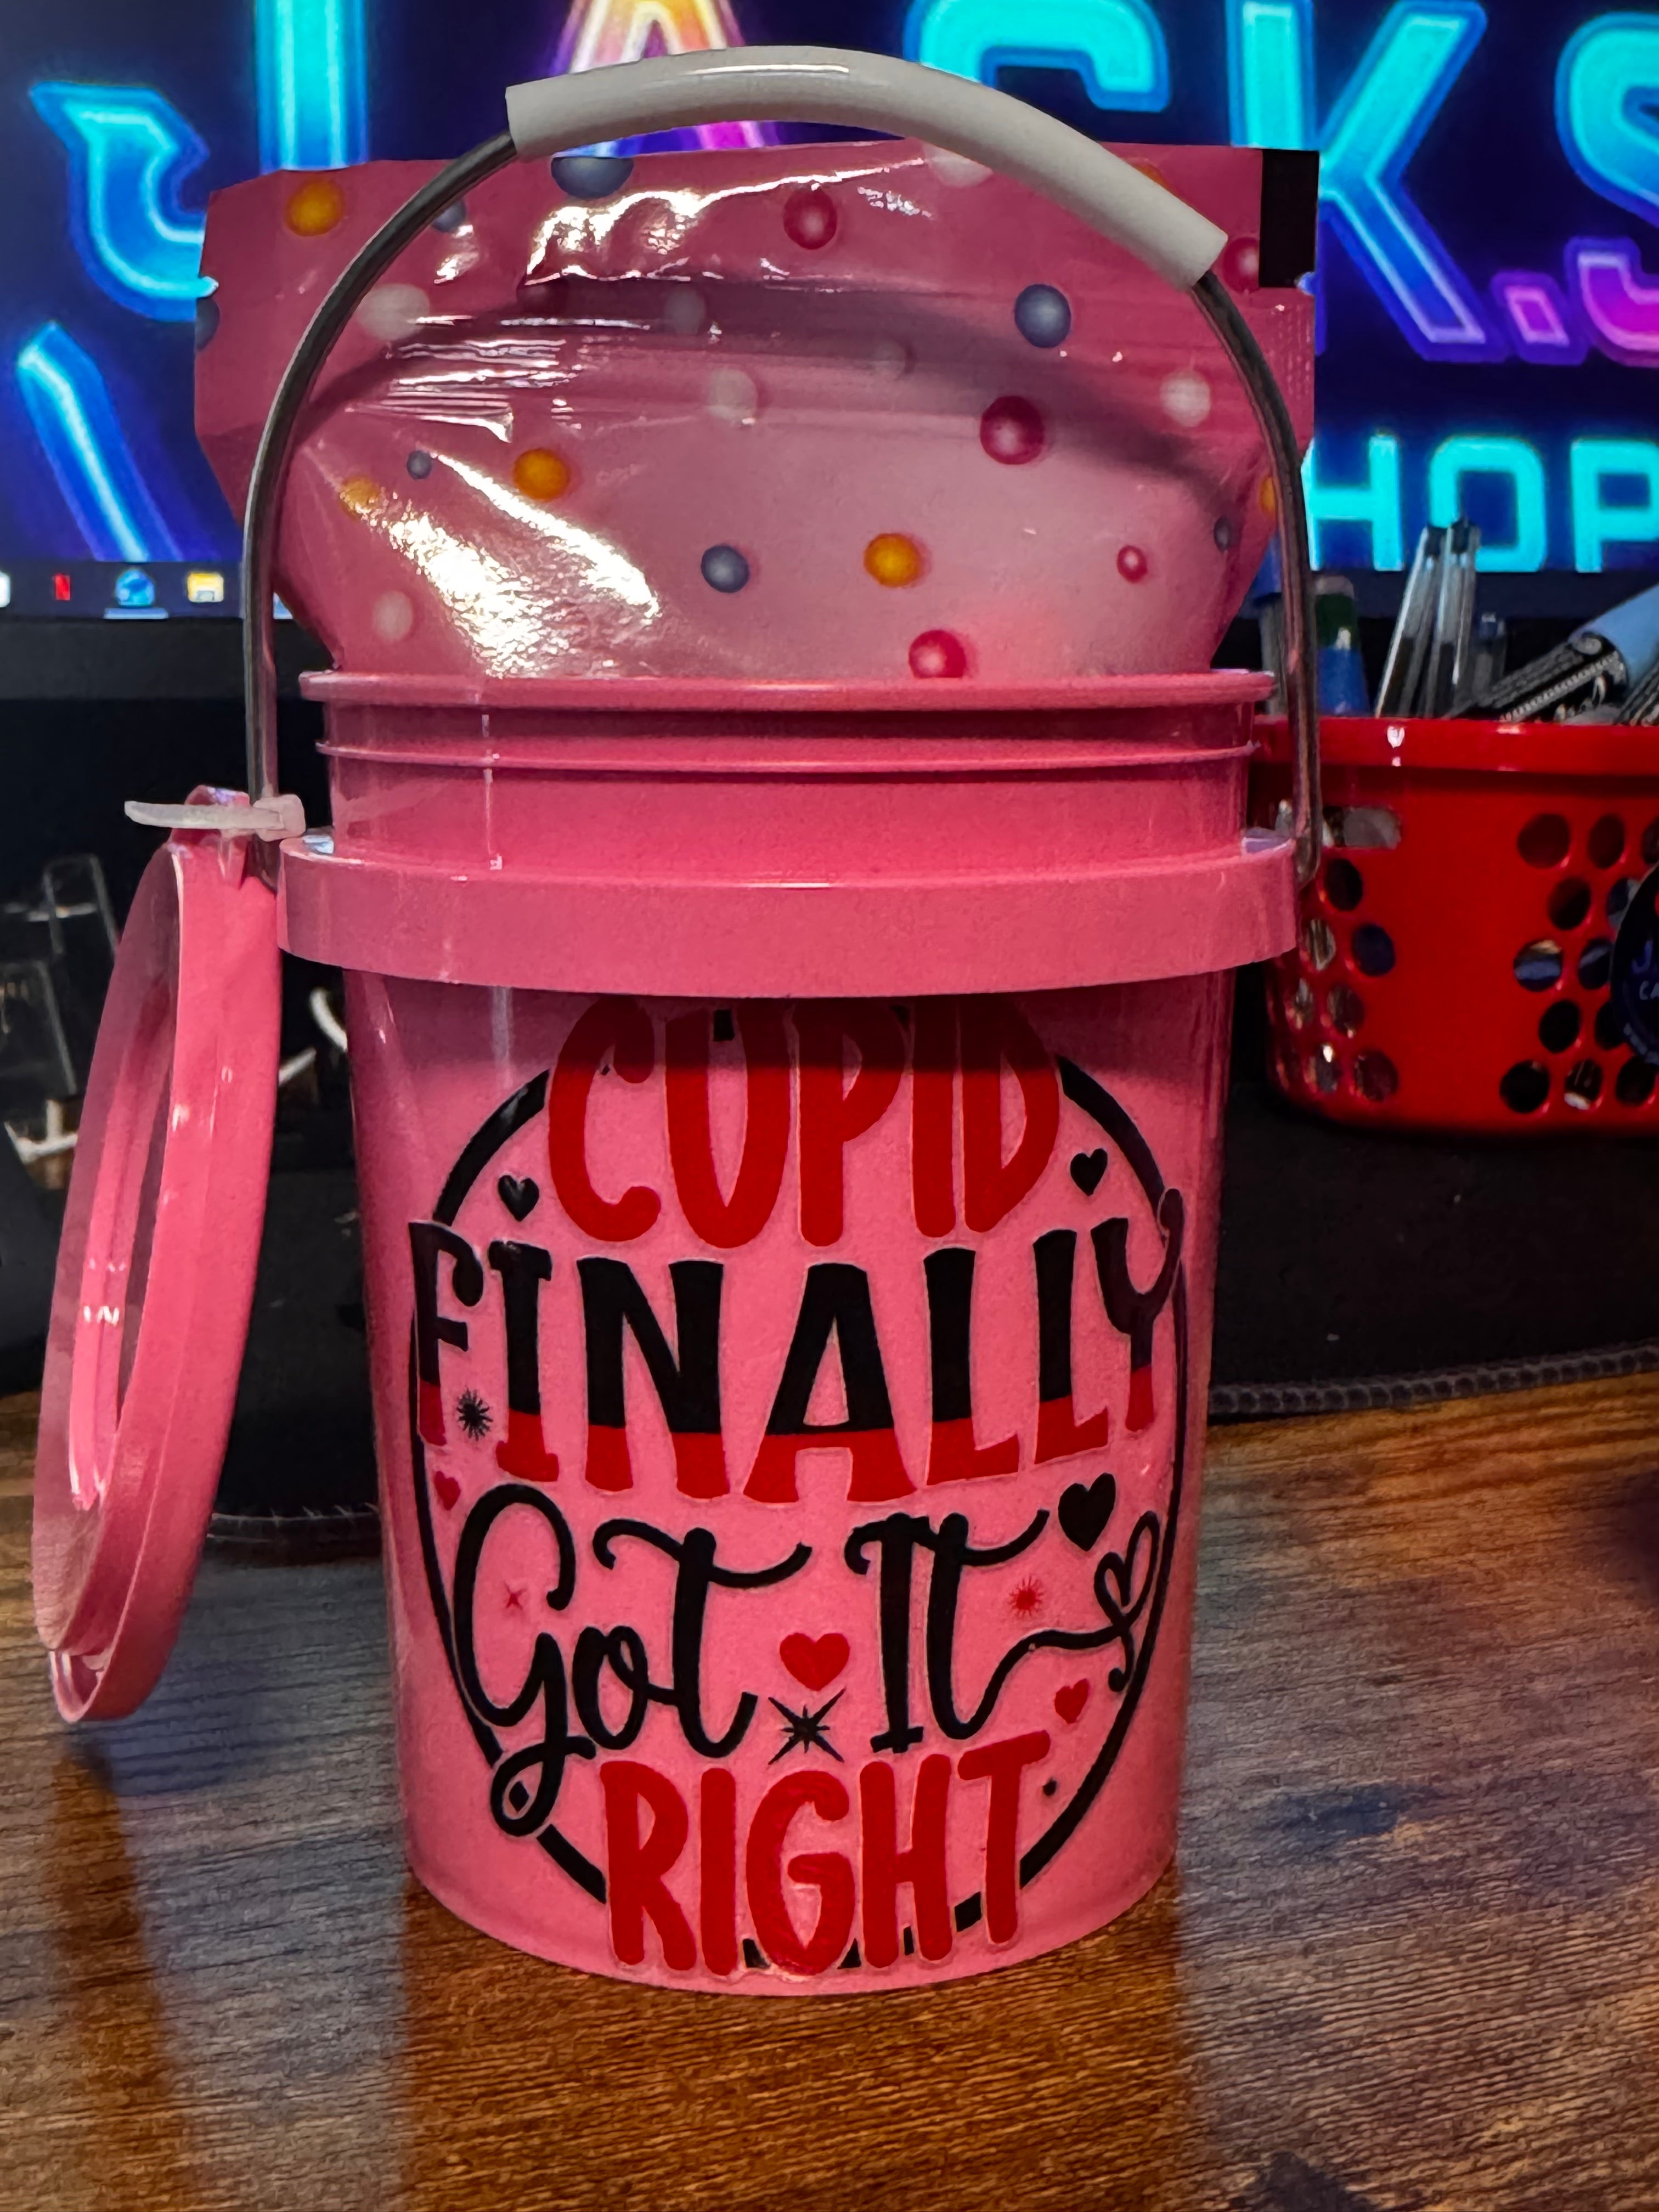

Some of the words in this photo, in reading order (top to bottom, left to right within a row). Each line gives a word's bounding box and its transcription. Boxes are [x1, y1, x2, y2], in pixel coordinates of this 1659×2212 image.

[549, 997, 1062, 1249] CUPID
[409, 1189, 1185, 1504] FINALLY
[453, 1483, 812, 1837] Got
[600, 1730, 1051, 1976] RIGHT
